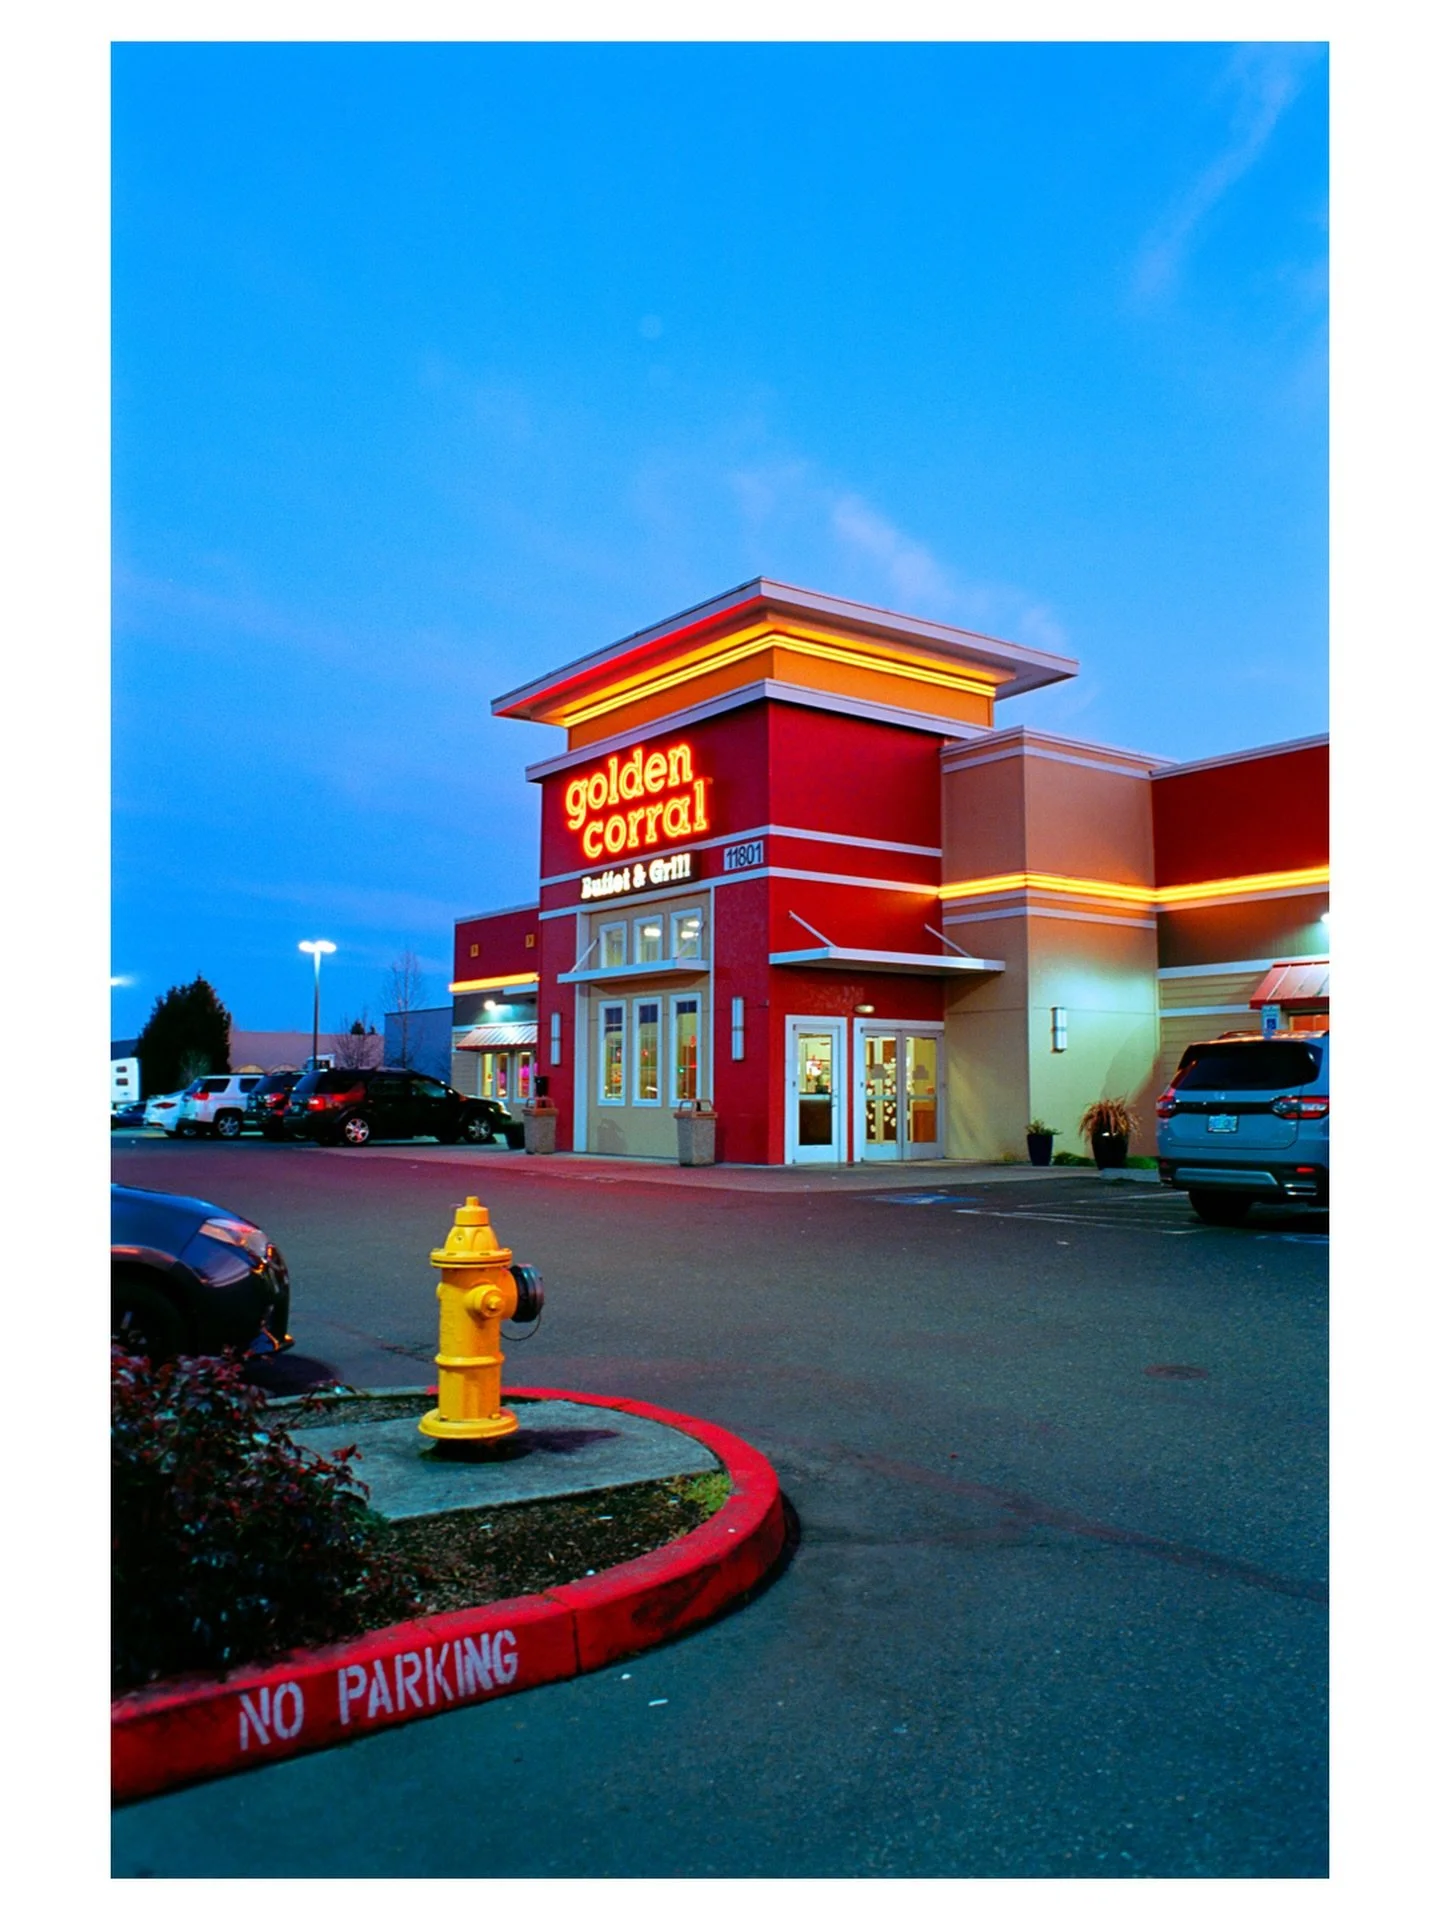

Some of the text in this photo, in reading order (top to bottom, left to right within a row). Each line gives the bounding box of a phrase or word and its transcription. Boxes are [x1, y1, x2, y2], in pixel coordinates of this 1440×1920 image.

[565, 744, 693, 830] golden
[583, 779, 708, 858] corral
[581, 854, 691, 899] Buffet & Grill
[726, 844, 761, 869] 11801
[239, 1629, 518, 1751] NO PARKING
